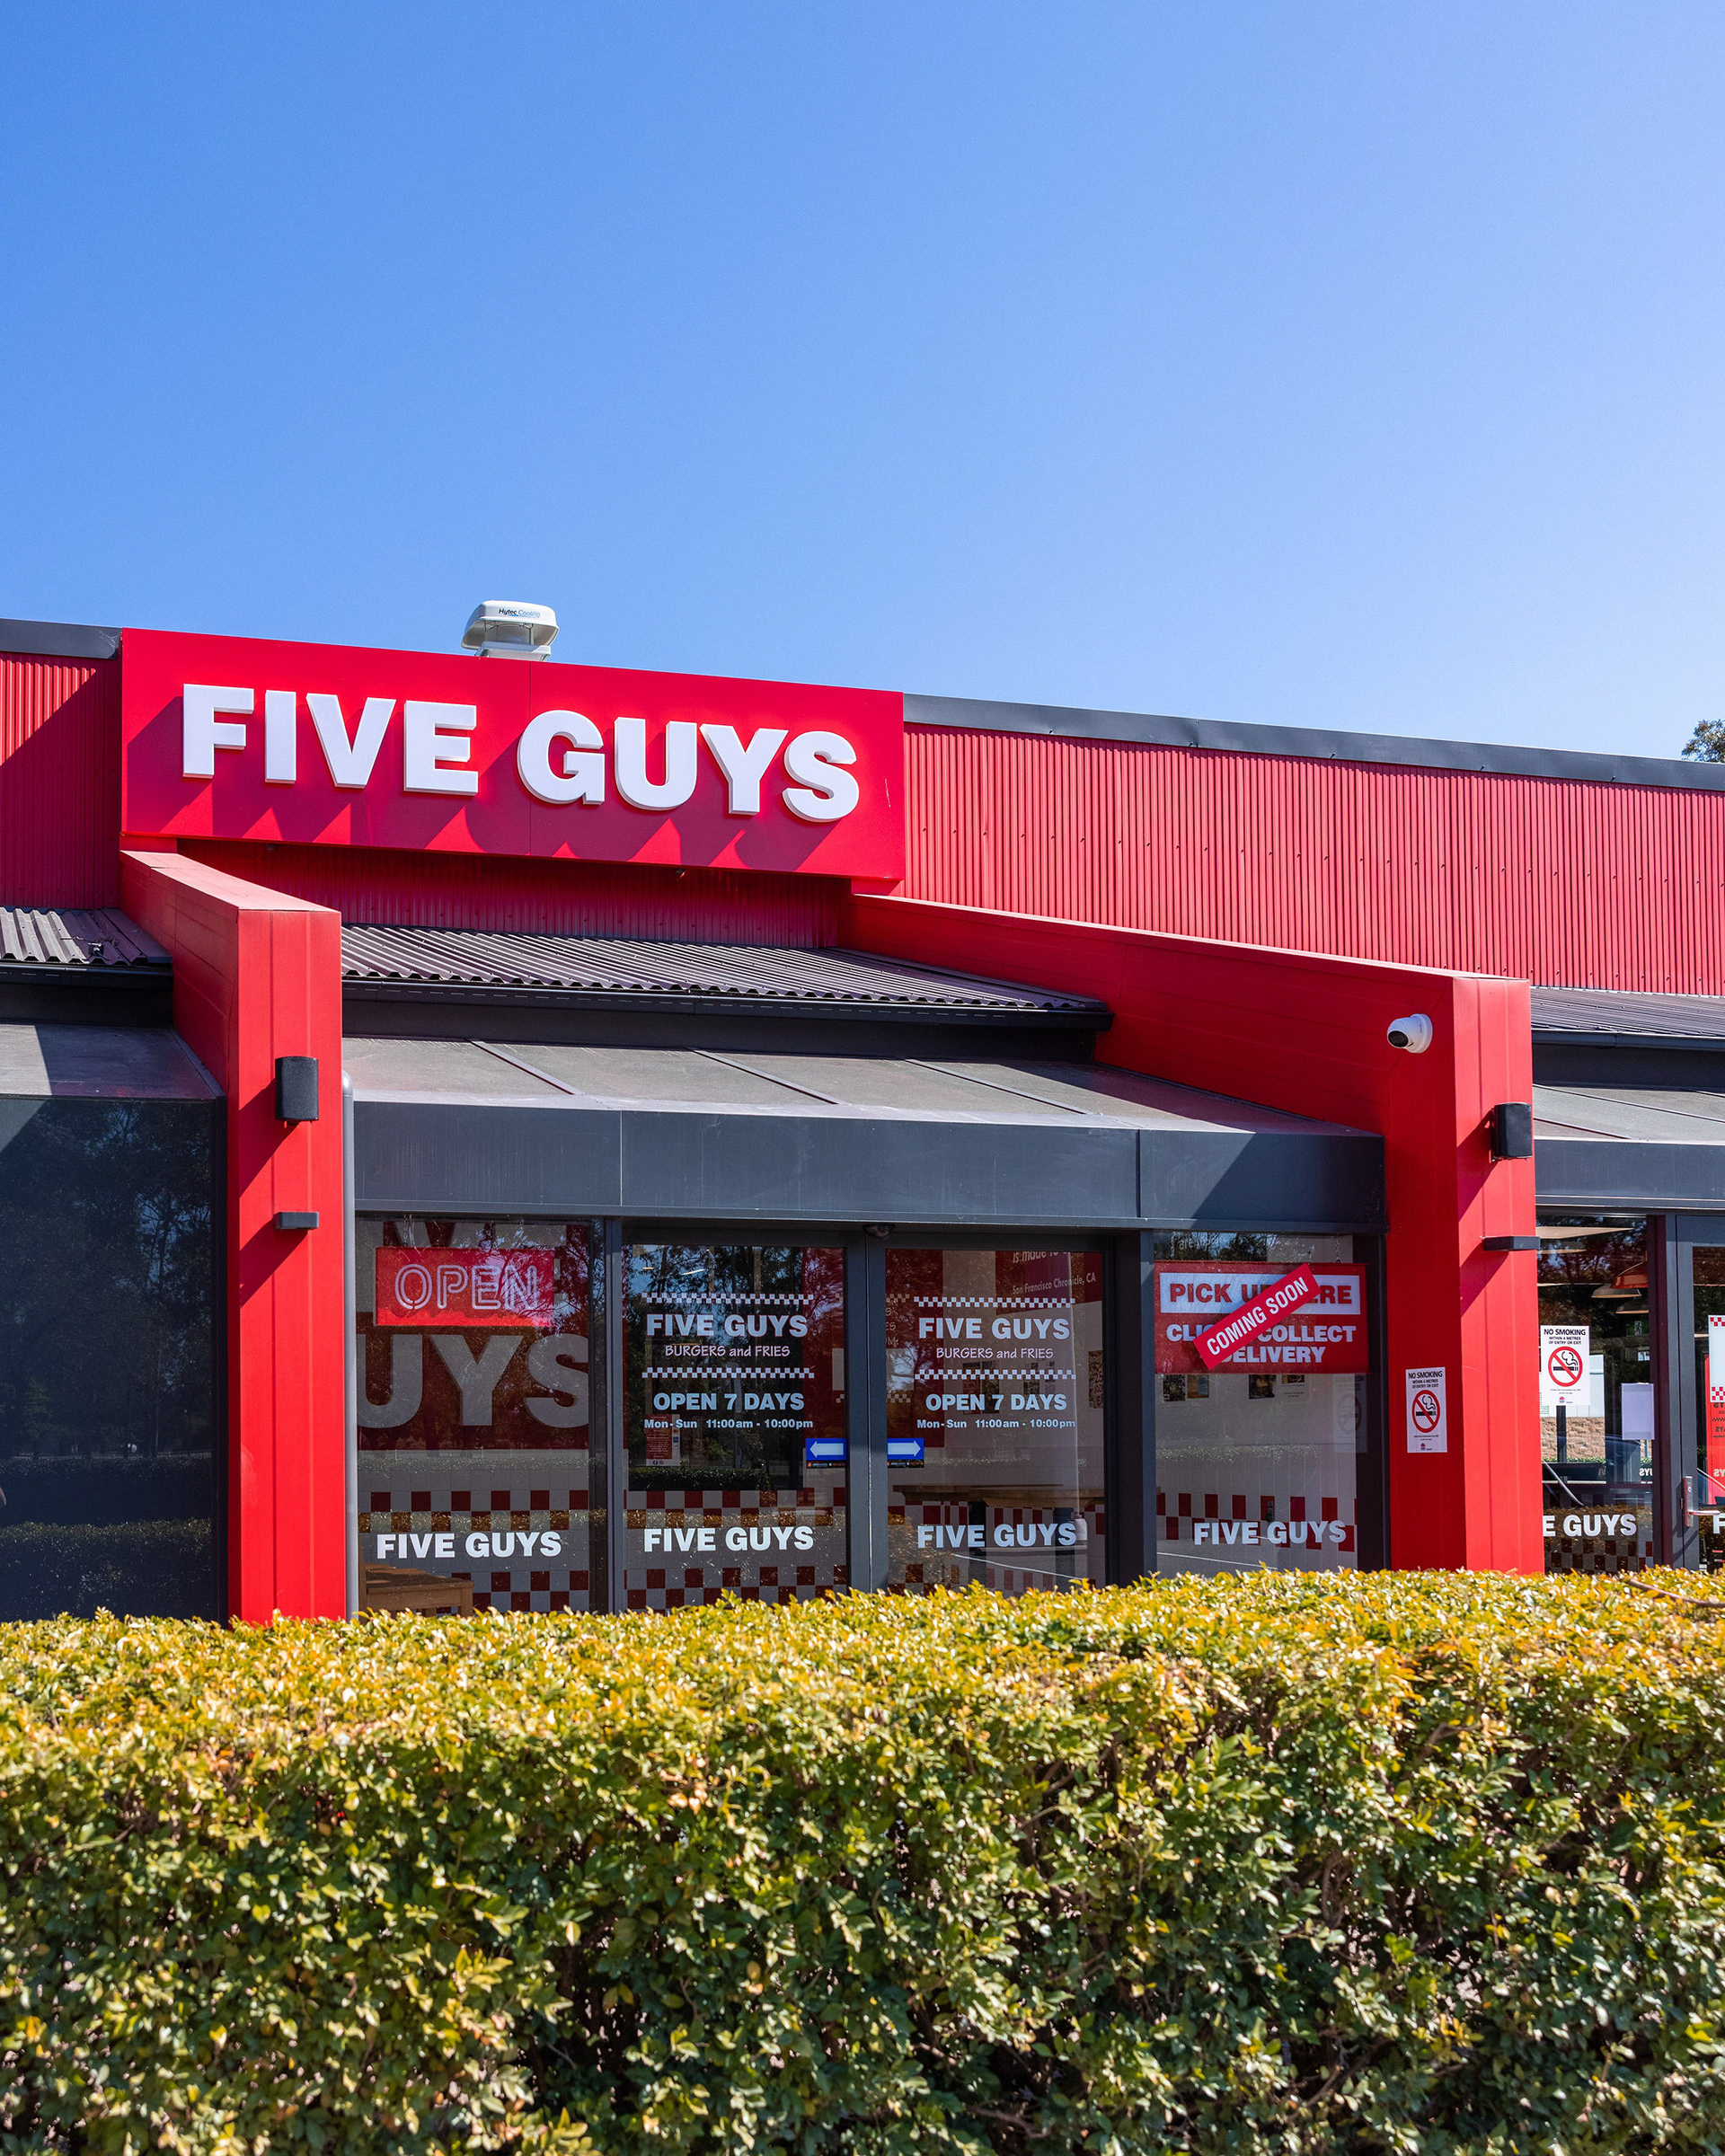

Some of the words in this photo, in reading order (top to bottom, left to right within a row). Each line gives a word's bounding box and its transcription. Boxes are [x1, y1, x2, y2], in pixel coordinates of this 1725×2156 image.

[499, 608, 518, 616] Hytec
[518, 609, 541, 618] Cooling
[182, 683, 478, 795] FIVE
[517, 709, 860, 823] GUYS
[394, 1263, 537, 1310] OPEN
[1013, 1285, 1023, 1294] San
[1024, 1280, 1052, 1292] Francisco
[1053, 1276, 1084, 1289] Chronicle,
[1085, 1272, 1096, 1283] CA
[1170, 1283, 1232, 1303] PICK
[1241, 1284, 1272, 1303] U
[646, 1313, 714, 1337] FIVE
[724, 1314, 809, 1338] GUYS
[1207, 1305, 1268, 1356] COMING
[1265, 1277, 1310, 1314] SOON
[918, 1317, 982, 1339] FIVE
[991, 1318, 1071, 1340] GUYS
[665, 1345, 726, 1357] BURGERS
[730, 1346, 752, 1357] and
[755, 1346, 791, 1357] FRIES
[936, 1348, 993, 1359] BURGERS
[996, 1348, 1017, 1359] and
[1021, 1348, 1054, 1359] FRIES
[1417, 1371, 1443, 1379] SMOKING
[653, 1392, 717, 1410] OPEN
[724, 1393, 738, 1410] 7
[744, 1392, 805, 1410] DAYS
[925, 1393, 986, 1411] OPEN
[991, 1394, 1004, 1411] 7
[1011, 1393, 1067, 1411] DAYS
[917, 1524, 986, 1549] FIVE
[993, 1522, 1077, 1547] GUYS
[1193, 1522, 1260, 1545] FIVE
[1267, 1519, 1347, 1544] GUYS
[1563, 1514, 1637, 1537] GUYS
[376, 1533, 456, 1560] FIVE
[464, 1531, 562, 1559] GUYS
[643, 1528, 716, 1552] FIVE
[725, 1526, 814, 1552] GUYS
